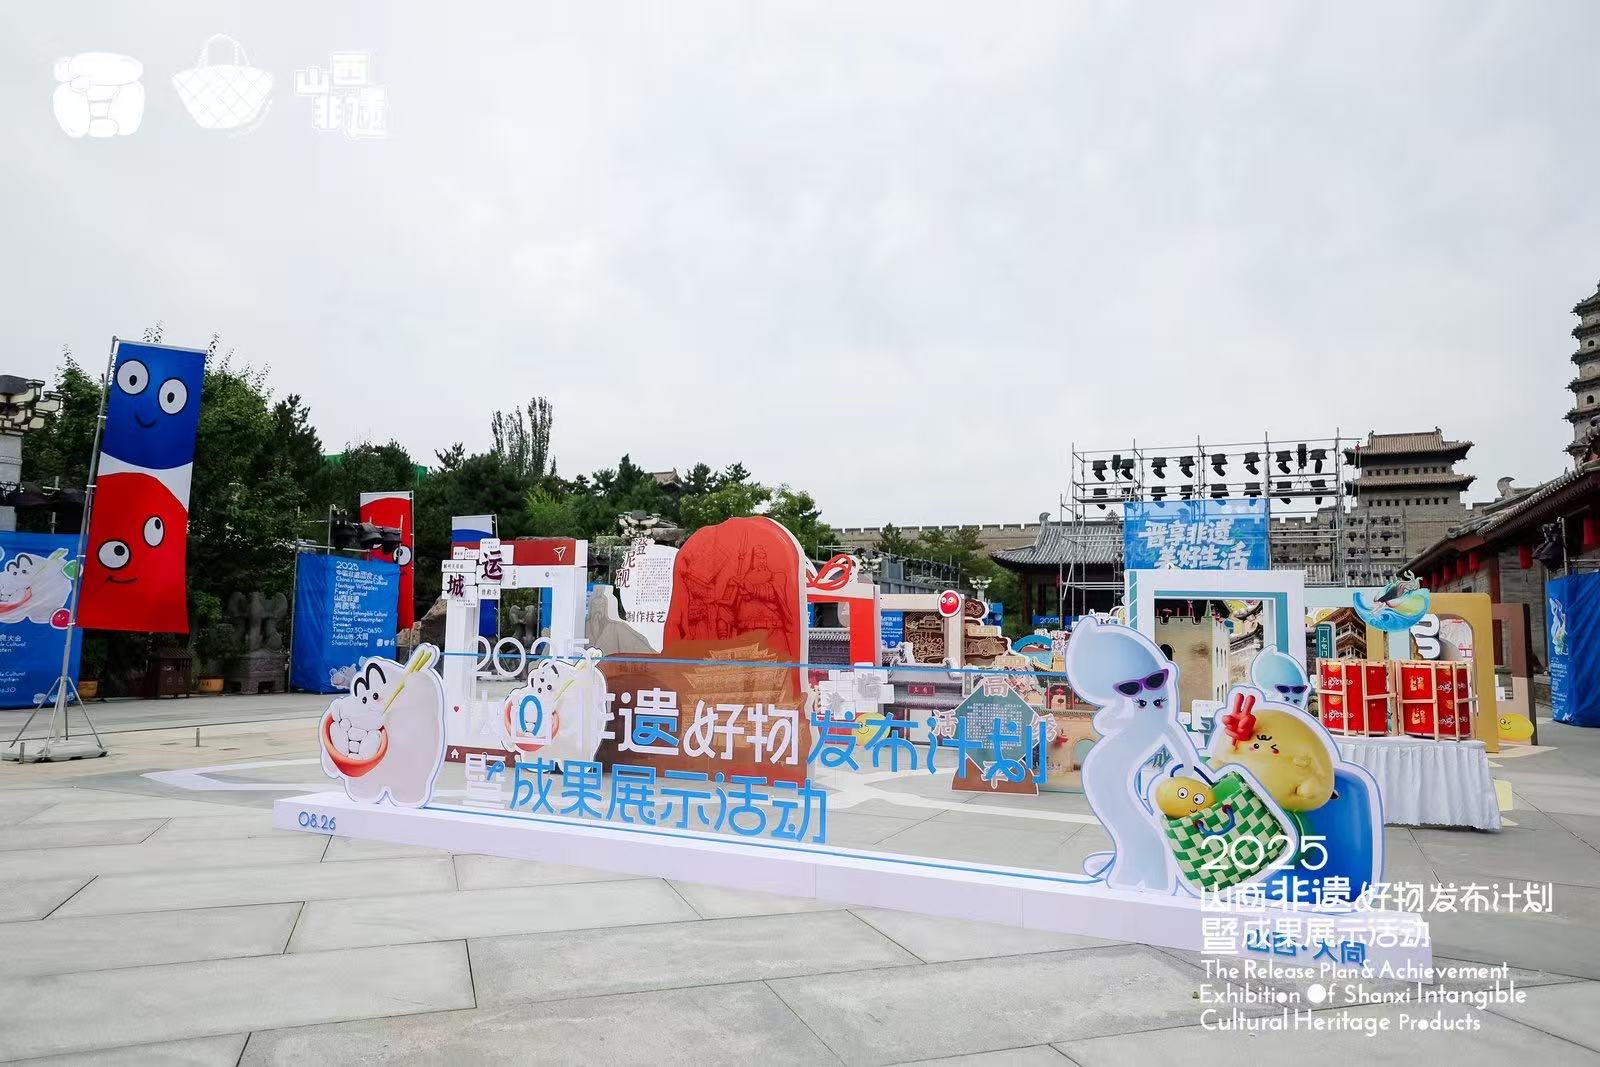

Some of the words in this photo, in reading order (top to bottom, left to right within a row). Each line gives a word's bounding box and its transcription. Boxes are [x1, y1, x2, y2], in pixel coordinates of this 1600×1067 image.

[1138, 518, 1235, 548] 晋享非遗
[1154, 541, 1251, 570] 美好生活
[298, 810, 337, 830] 08.26
